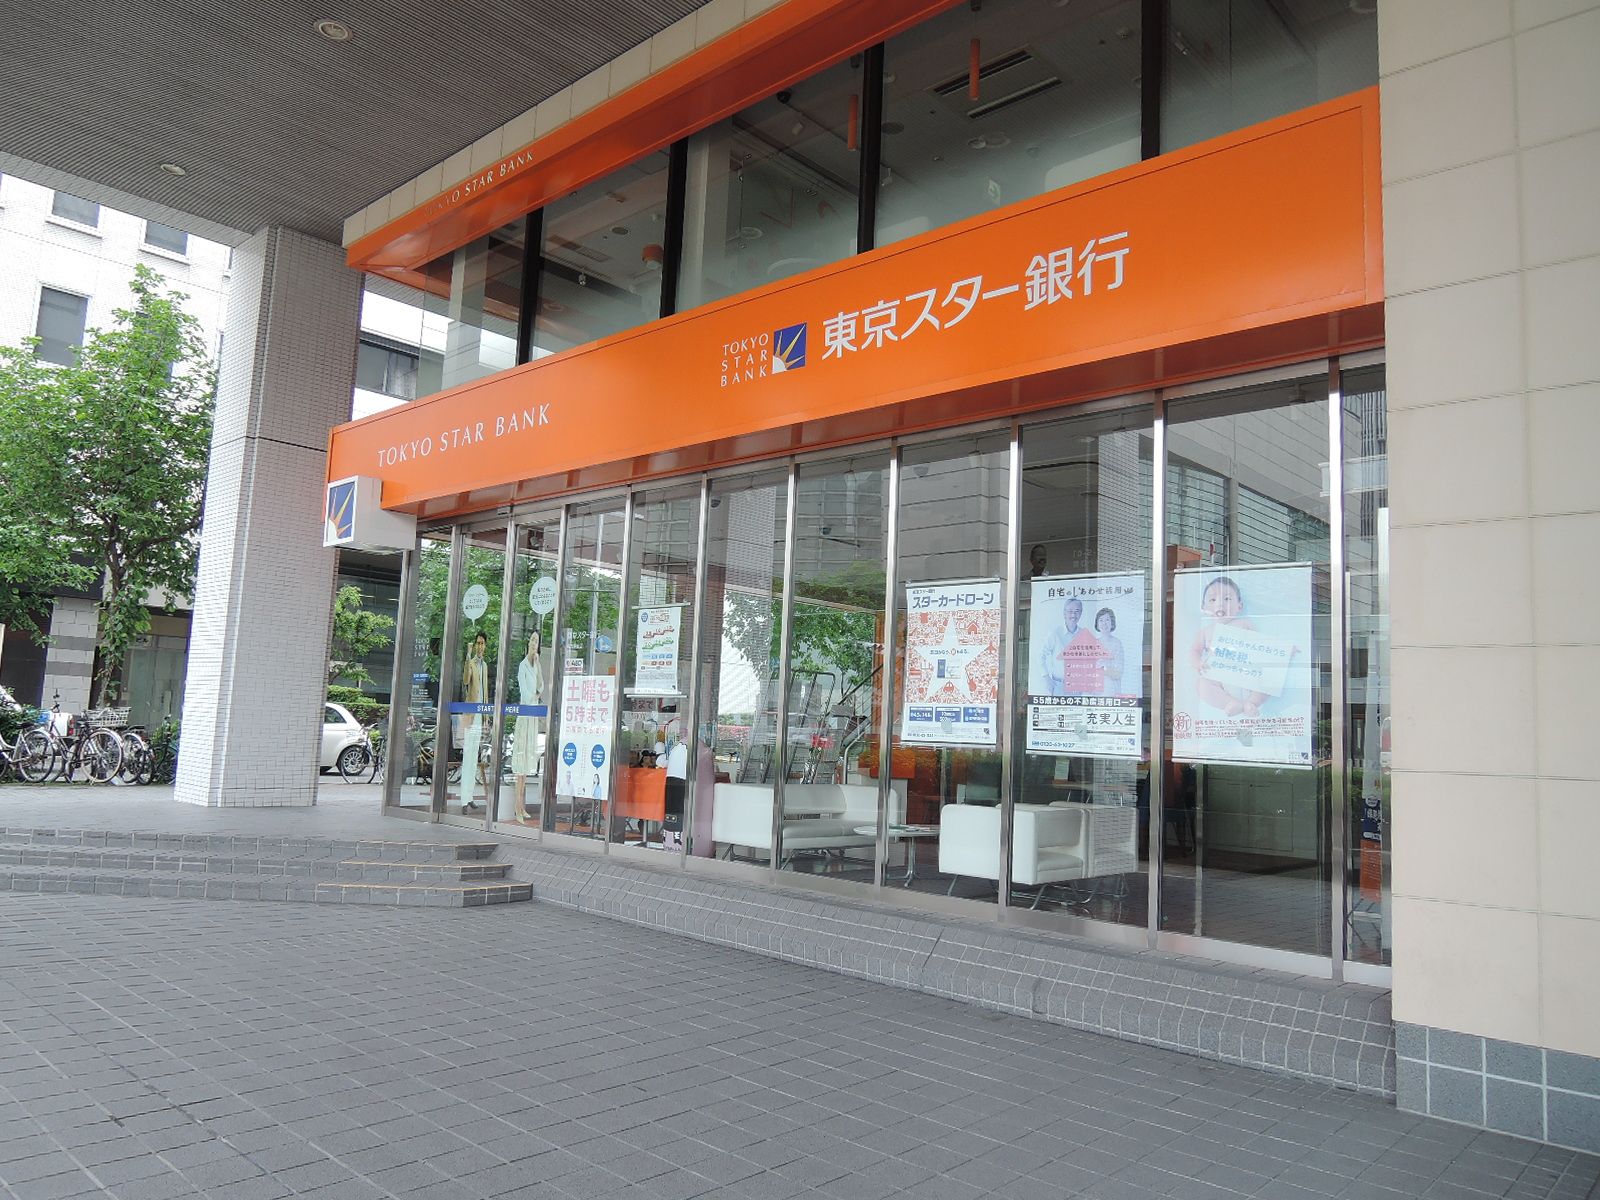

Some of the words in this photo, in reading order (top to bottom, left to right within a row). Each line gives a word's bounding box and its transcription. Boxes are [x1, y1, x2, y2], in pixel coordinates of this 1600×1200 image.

[464, 171, 494, 196] STAR
[499, 151, 534, 177] BANK
[821, 231, 1130, 361] 東京スター銀行
[722, 332, 769, 356] TOKYO
[721, 348, 768, 372] STAR
[720, 364, 768, 388] BANK
[377, 436, 433, 468] TOKYO
[439, 421, 484, 451] STAR
[494, 403, 551, 437] BANK
[912, 592, 994, 609] スターカードローン
[567, 680, 610, 703] 土曜も
[505, 706, 520, 714] HERE
[565, 706, 609, 723] 5時まで
[1086, 712, 1136, 726] 充実人生
